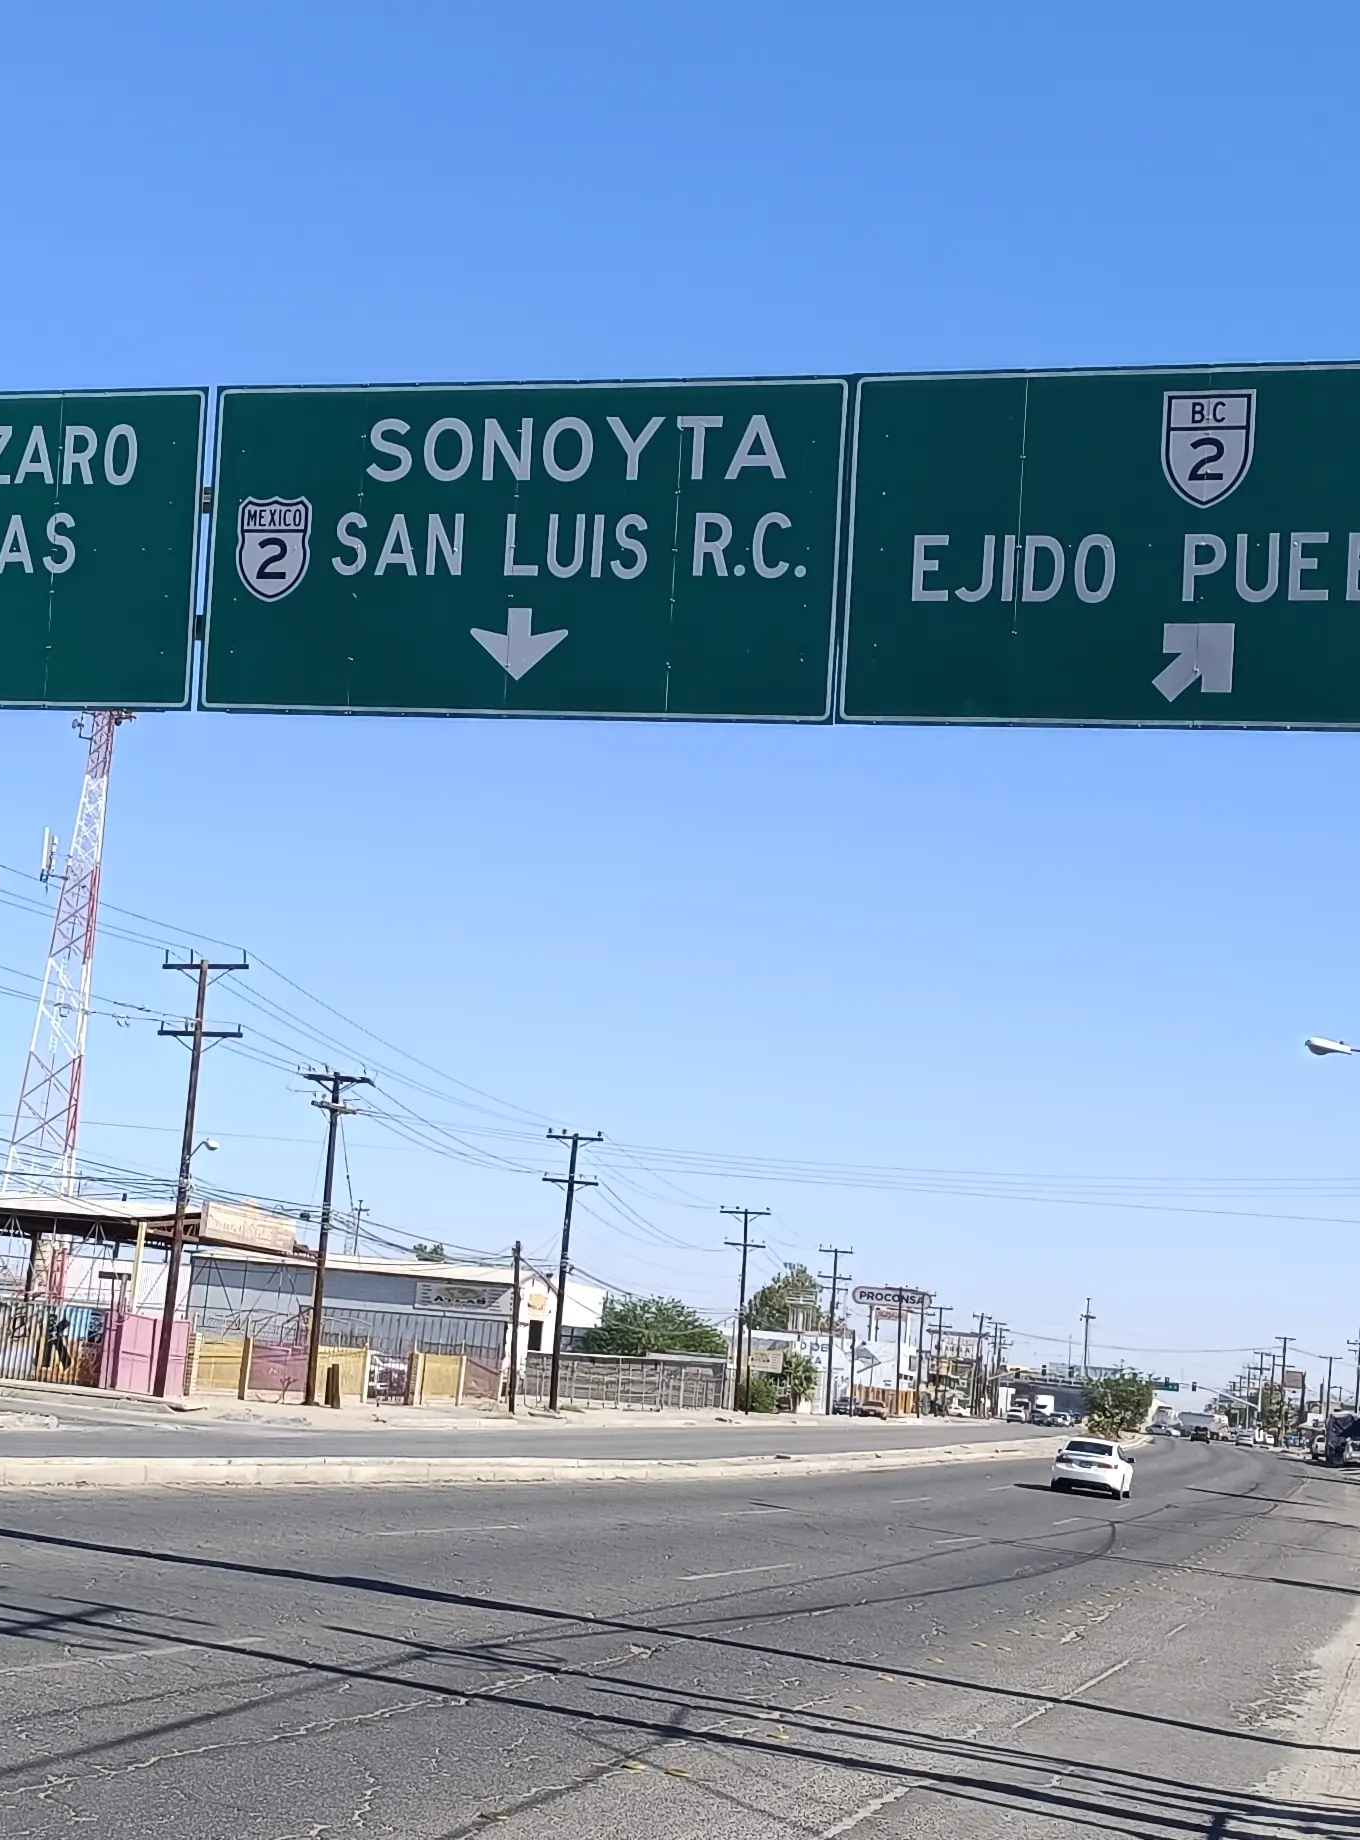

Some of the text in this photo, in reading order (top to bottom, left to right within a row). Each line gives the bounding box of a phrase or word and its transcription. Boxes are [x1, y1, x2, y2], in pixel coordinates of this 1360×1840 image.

[365, 414, 787, 483] SONOYTA
[1187, 437, 1225, 481] 2
[246, 508, 302, 527] MEXICO
[331, 511, 807, 580] SAN LUIS R.C.
[255, 537, 288, 580] 2
[911, 533, 1116, 604] EJIDO
